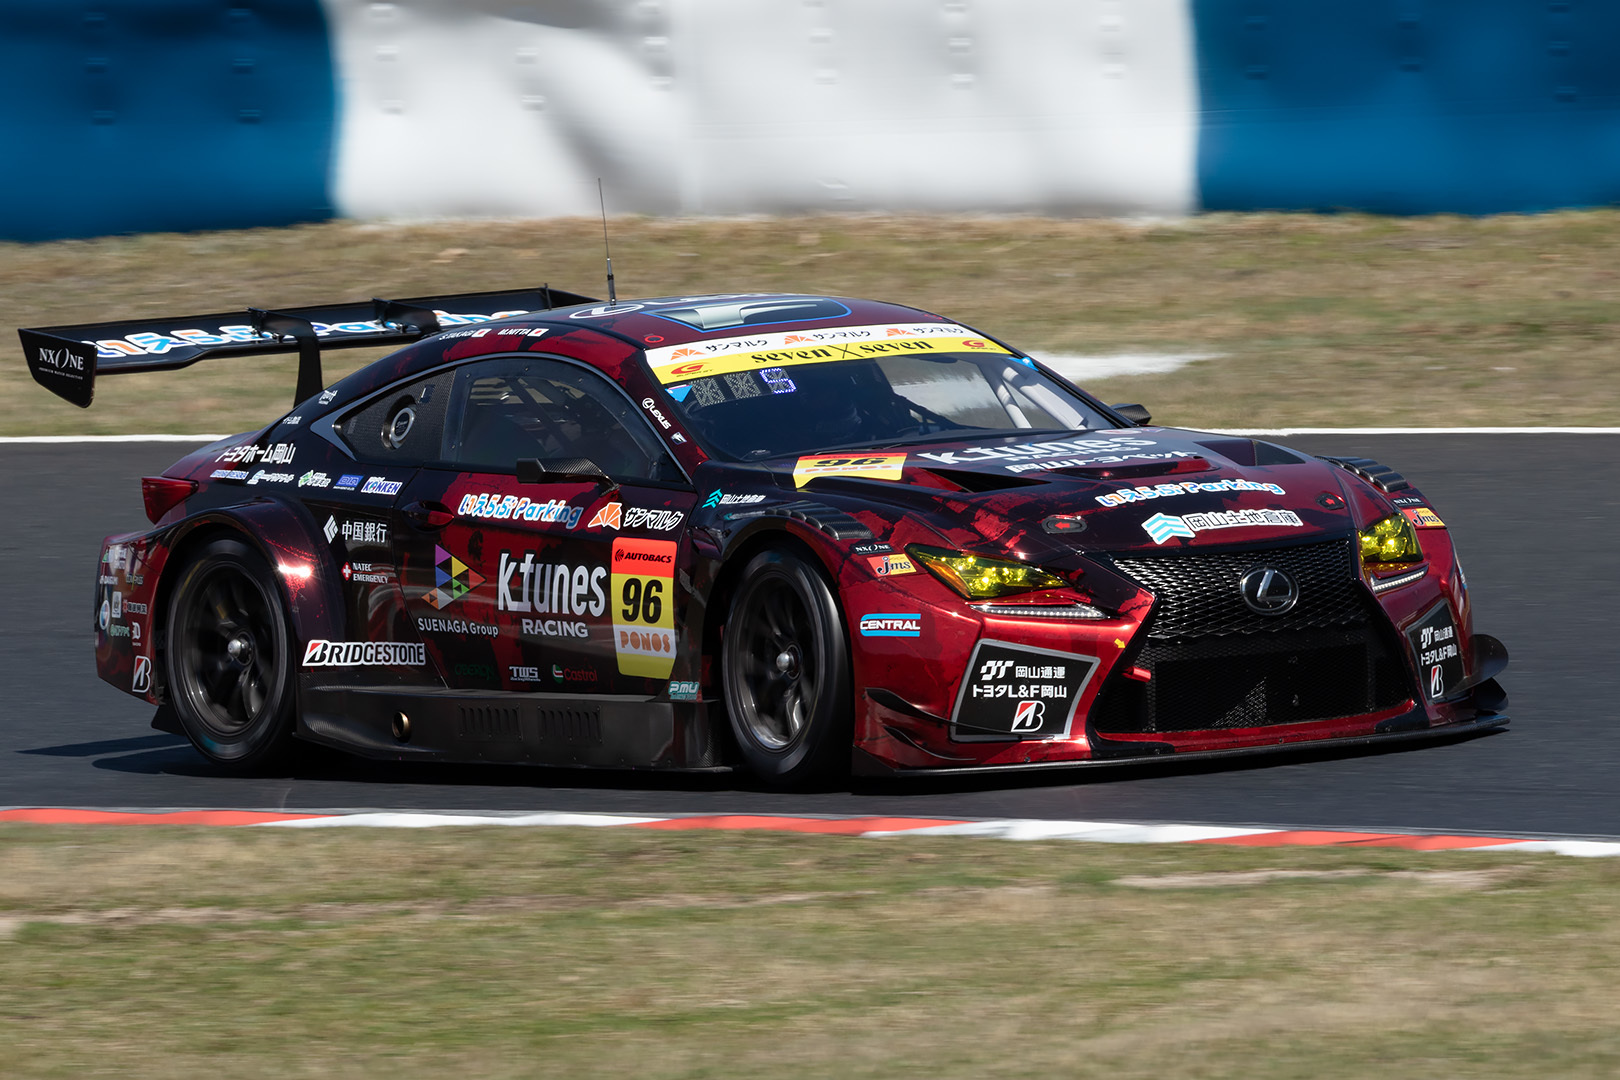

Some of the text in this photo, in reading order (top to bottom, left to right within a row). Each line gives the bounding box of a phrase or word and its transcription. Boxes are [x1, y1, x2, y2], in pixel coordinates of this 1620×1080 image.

[813, 329, 871, 341] サンマルク
[705, 339, 768, 352] サンマルク
[751, 347, 832, 363] seven
[859, 340, 934, 354] seven
[649, 403, 672, 430] LEXUS
[215, 443, 296, 464] トヨタホーム岡山
[814, 458, 888, 467] 96
[624, 508, 683, 531] サンマルク
[1184, 509, 1303, 531] 岡山土地倉庫
[341, 520, 387, 543] 中国銀行
[352, 562, 372, 571] NATEC
[625, 553, 673, 564] AUTOBACS
[353, 573, 388, 584] EMERGENCY
[622, 578, 663, 624] 96
[418, 617, 500, 638] SUENAGA Group
[522, 618, 588, 637] RACING
[860, 620, 921, 630] CENTRAL
[619, 631, 671, 653] PONOS
[303, 640, 426, 666] BRIDGESTONE
[509, 666, 538, 678] TWS
[563, 668, 598, 682] Castrol
[1015, 665, 1066, 679] 岡山通運
[972, 684, 1067, 699] トヨタL&F岡山
